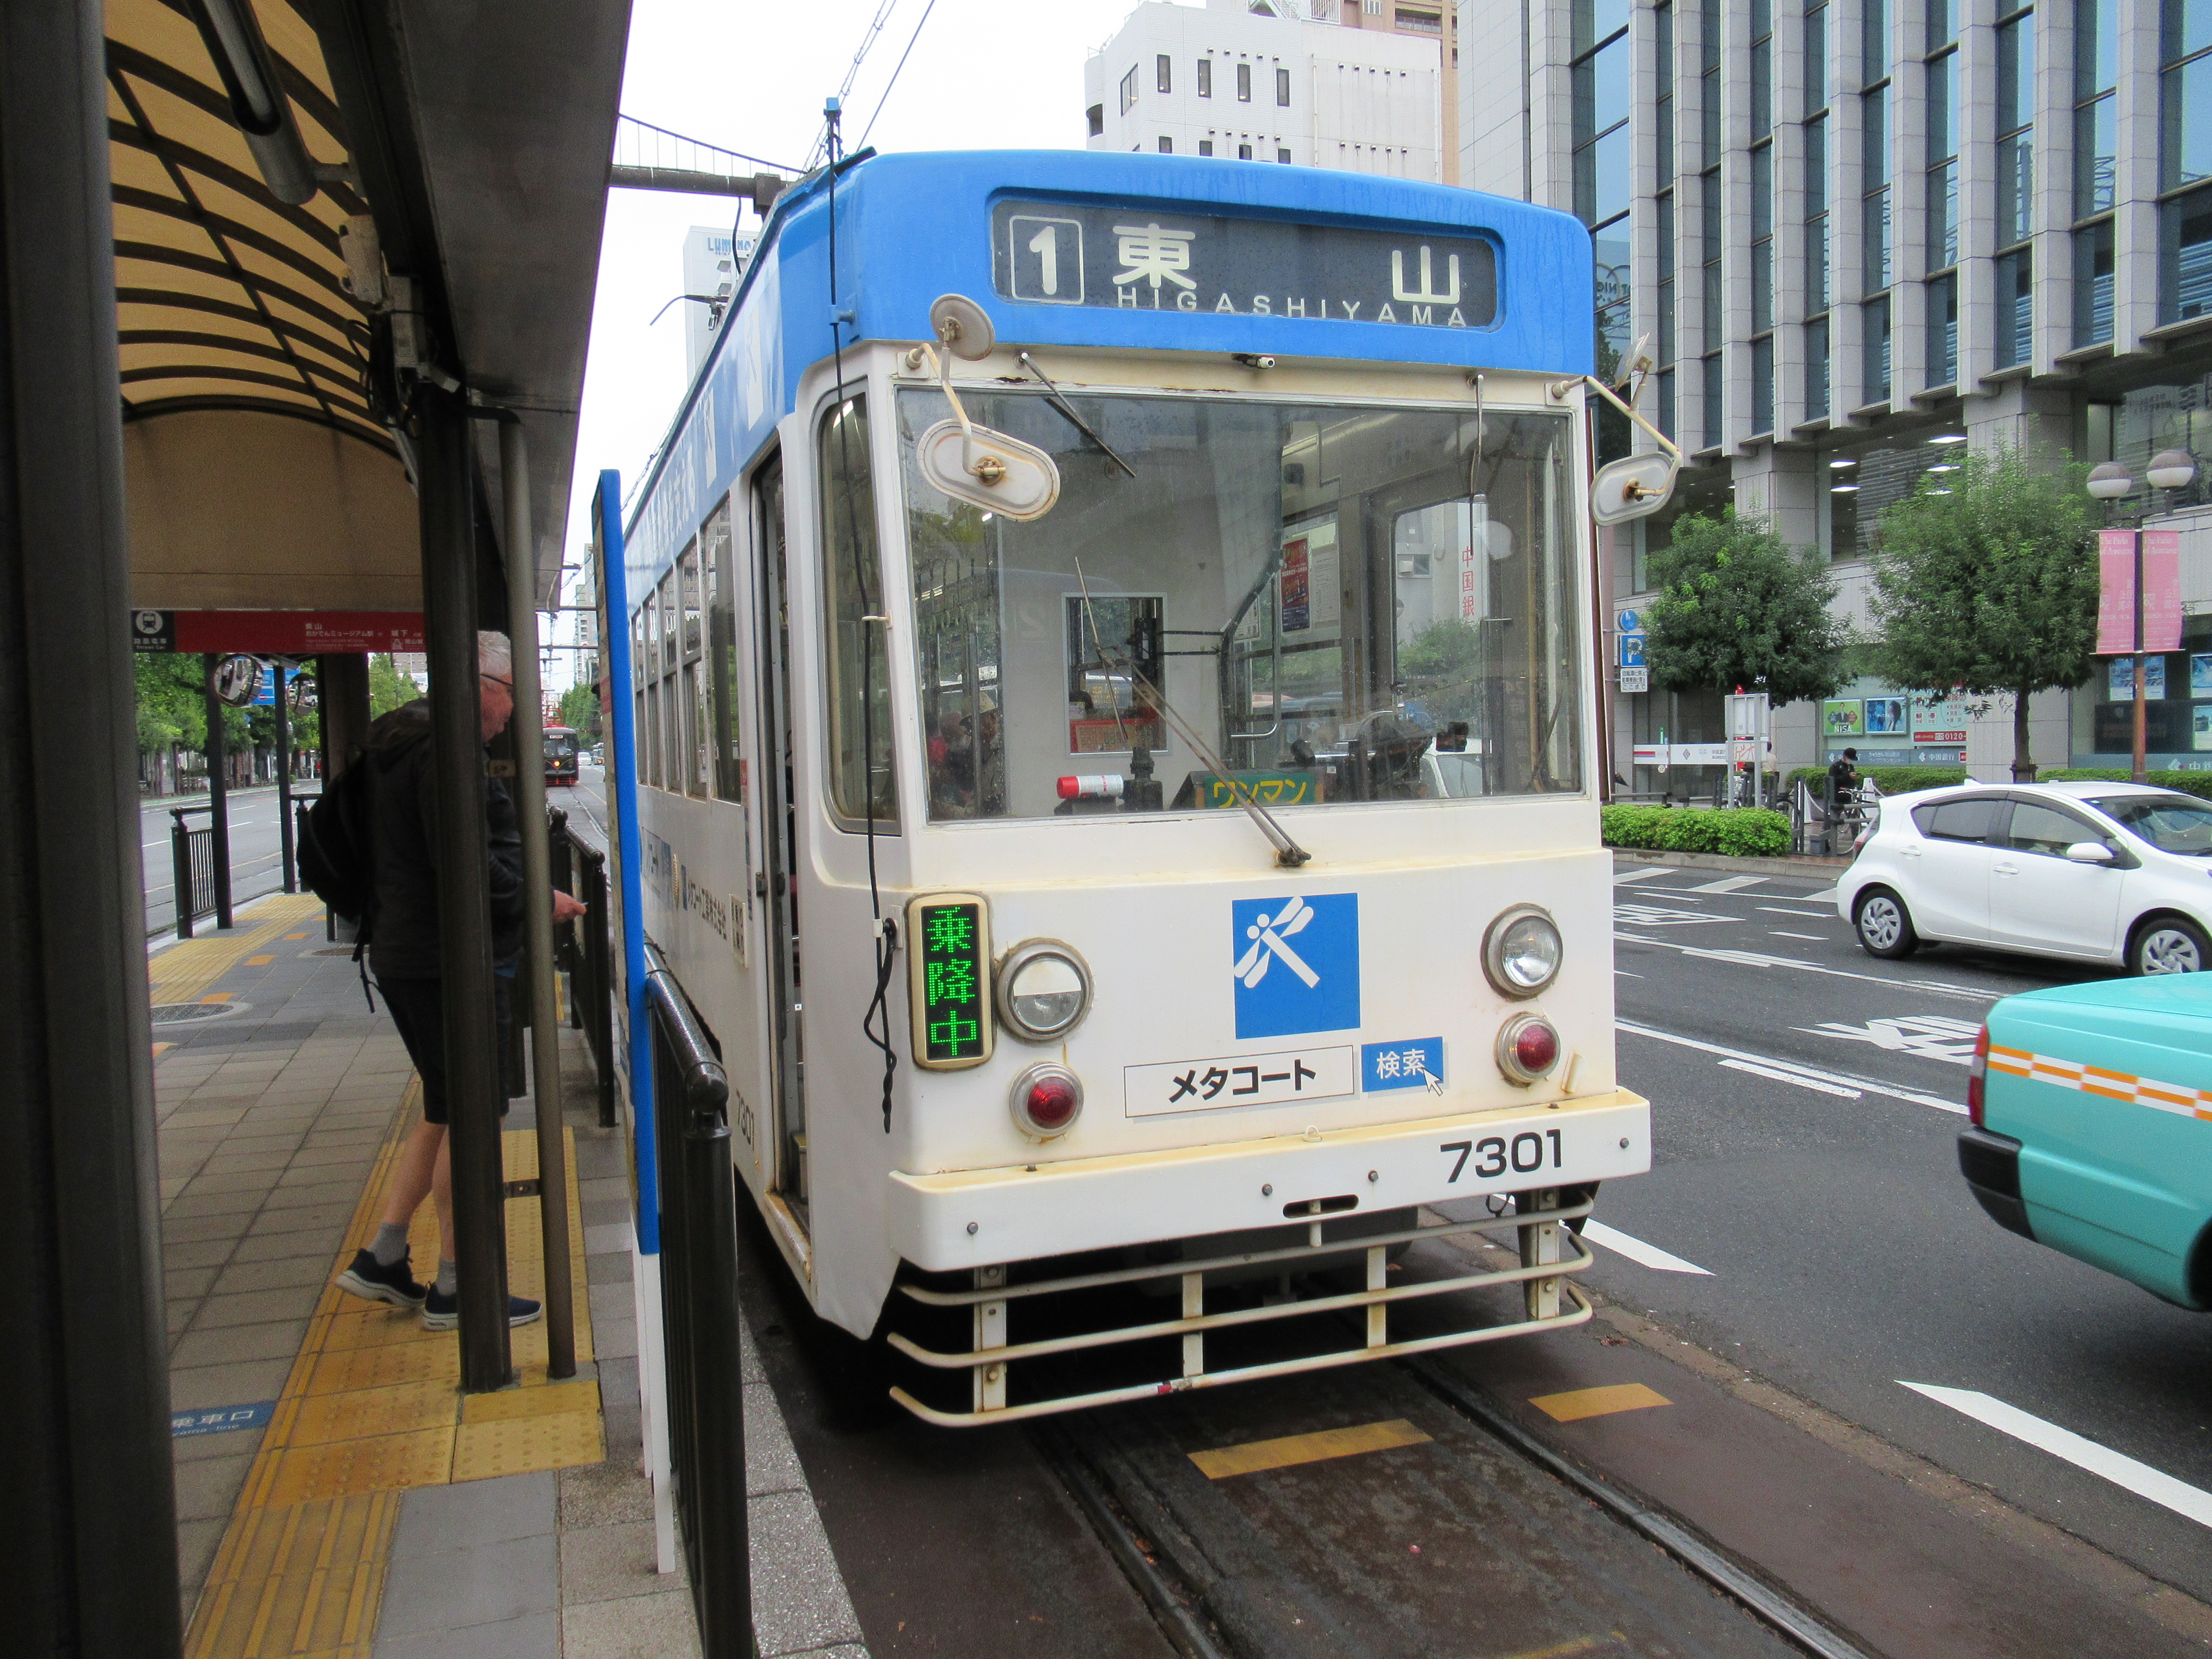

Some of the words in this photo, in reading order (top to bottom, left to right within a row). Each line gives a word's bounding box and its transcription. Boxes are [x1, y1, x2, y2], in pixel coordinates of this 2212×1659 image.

[1029, 225, 1057, 295] 1
[1117, 286, 1467, 327] HIGASHIYAMA
[1627, 638, 1642, 664] P
[1834, 725, 1852, 733] NISA
[1214, 779, 1307, 808] ワンマン
[926, 906, 977, 1058] 乗降中
[1167, 1059, 1317, 1104] メタコート
[1375, 1048, 1429, 1080] 検索
[736, 1088, 754, 1151] 7301
[1439, 1129, 1564, 1185] 7301
